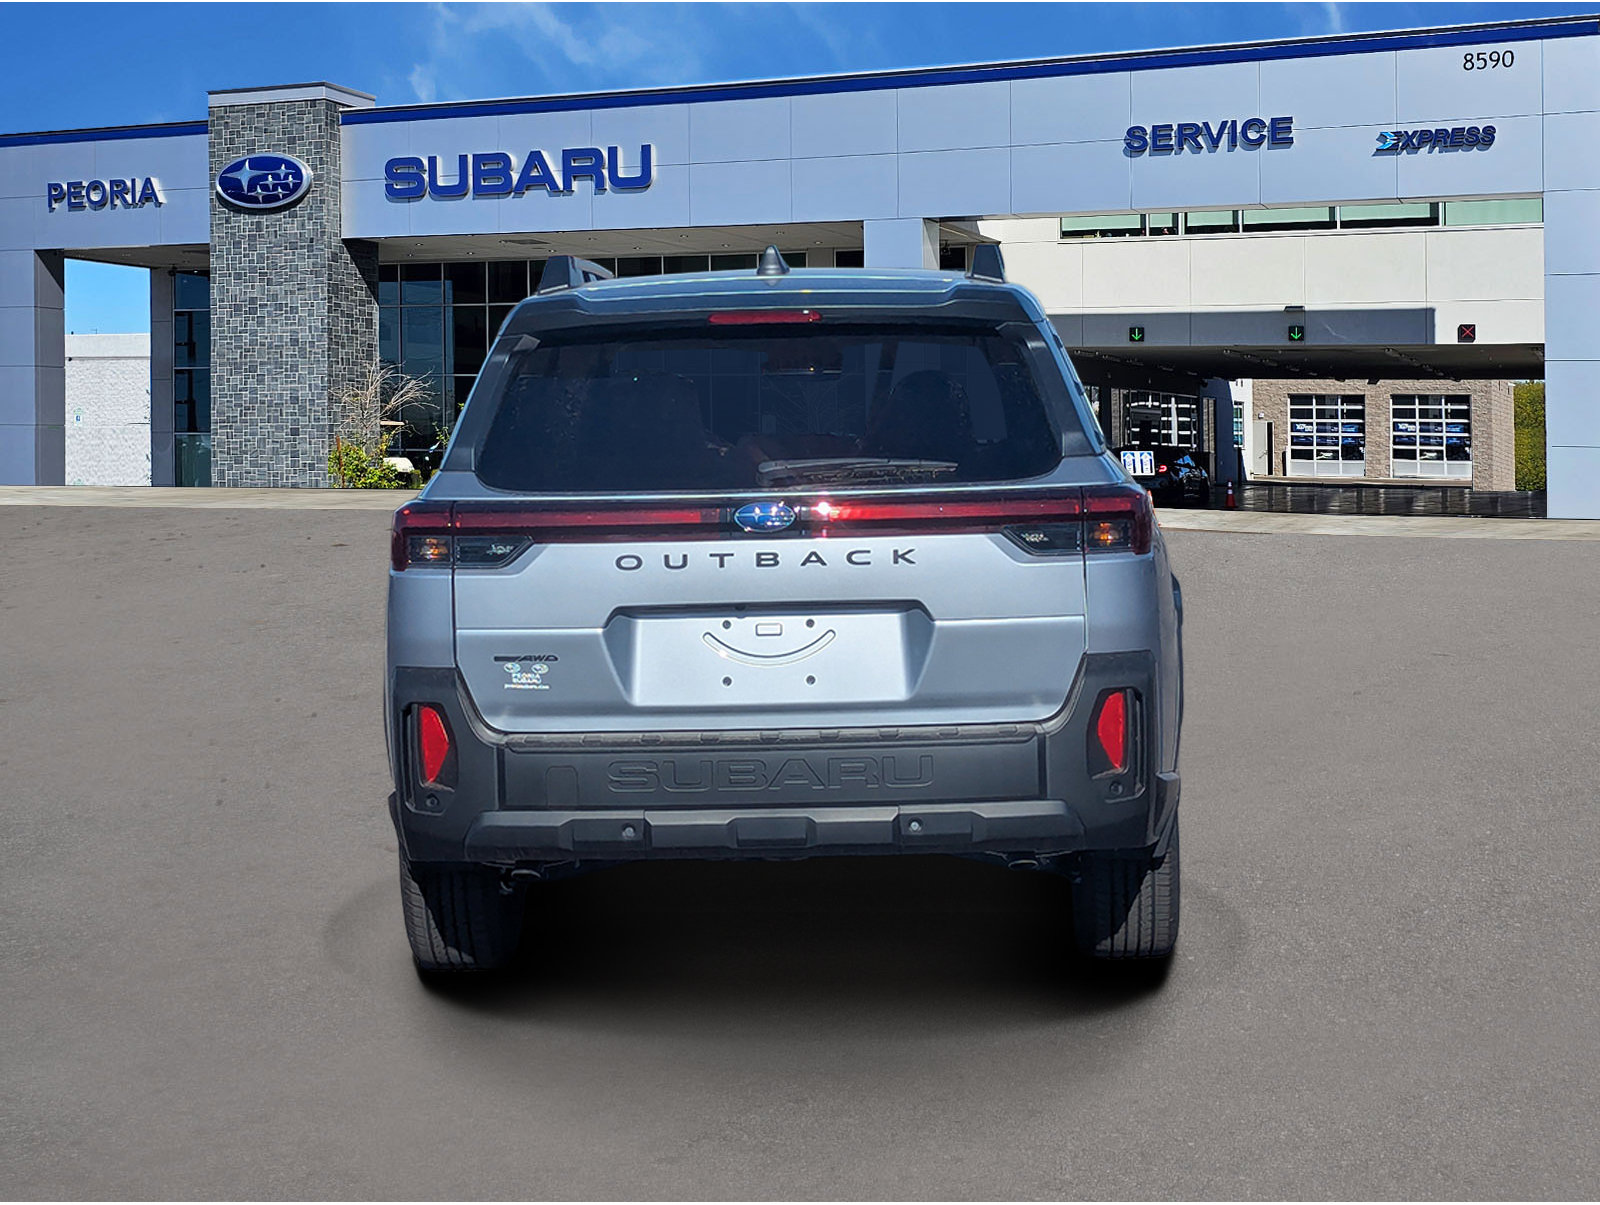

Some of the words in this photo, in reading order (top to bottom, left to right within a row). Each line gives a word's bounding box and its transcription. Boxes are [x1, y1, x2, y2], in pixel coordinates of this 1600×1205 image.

[1463, 50, 1514, 71] 8590
[1125, 116, 1294, 153] SERVICE
[1376, 125, 1497, 152] EXPRESS
[384, 143, 653, 200] SUBARU
[47, 177, 162, 211] PEORIA
[615, 549, 917, 570] OUTBACK
[607, 755, 934, 792] SUBARU
